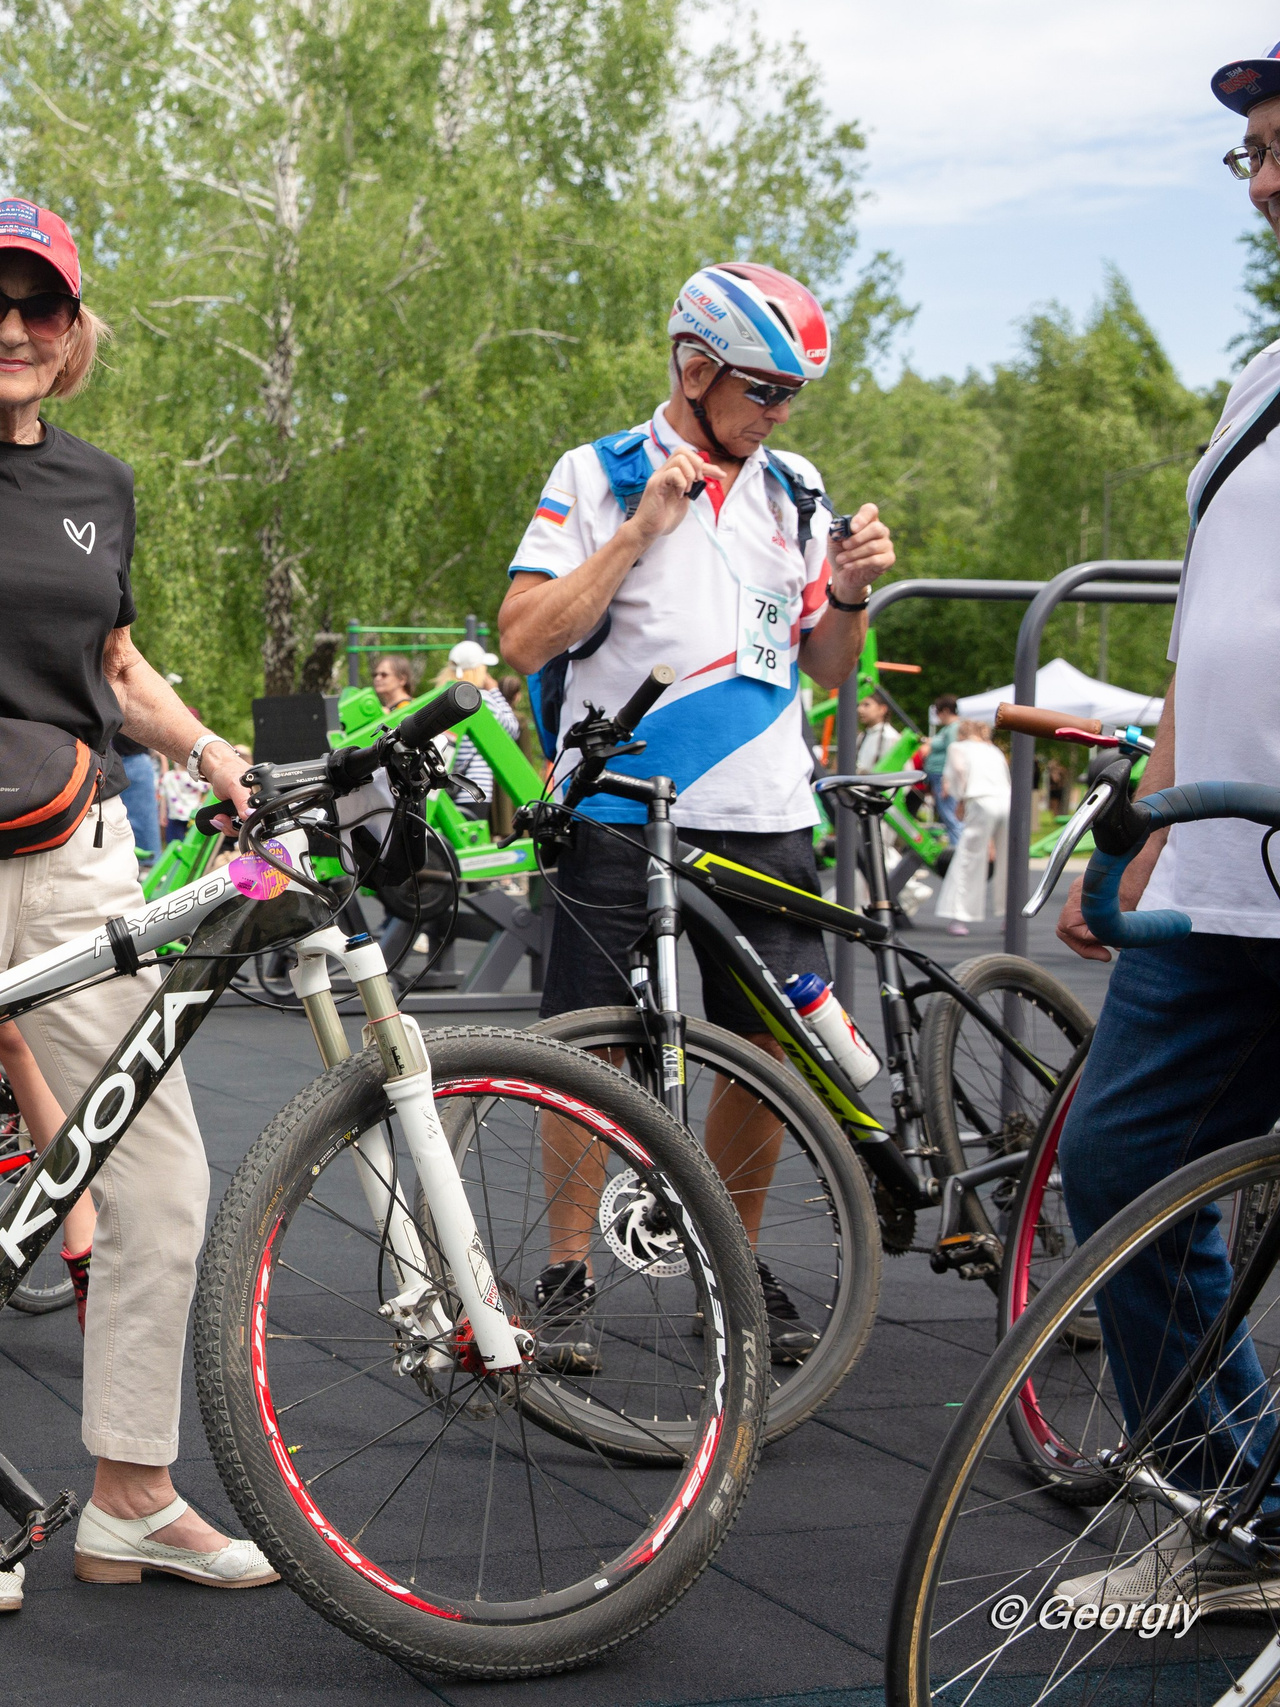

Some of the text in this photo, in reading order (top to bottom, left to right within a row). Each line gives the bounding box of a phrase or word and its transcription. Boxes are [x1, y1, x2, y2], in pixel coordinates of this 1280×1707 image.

[1218, 68, 1262, 95] RUSSIA
[1225, 66, 1243, 78] TEAM
[694, 321, 729, 350] GIRO
[754, 598, 778, 625] 78
[752, 644, 777, 670] 78
[489, 1079, 652, 1168] ZERO
[238, 1184, 285, 1322] handmade in germany
[660, 1172, 727, 1417] METAL
[650, 1416, 718, 1553] RED
